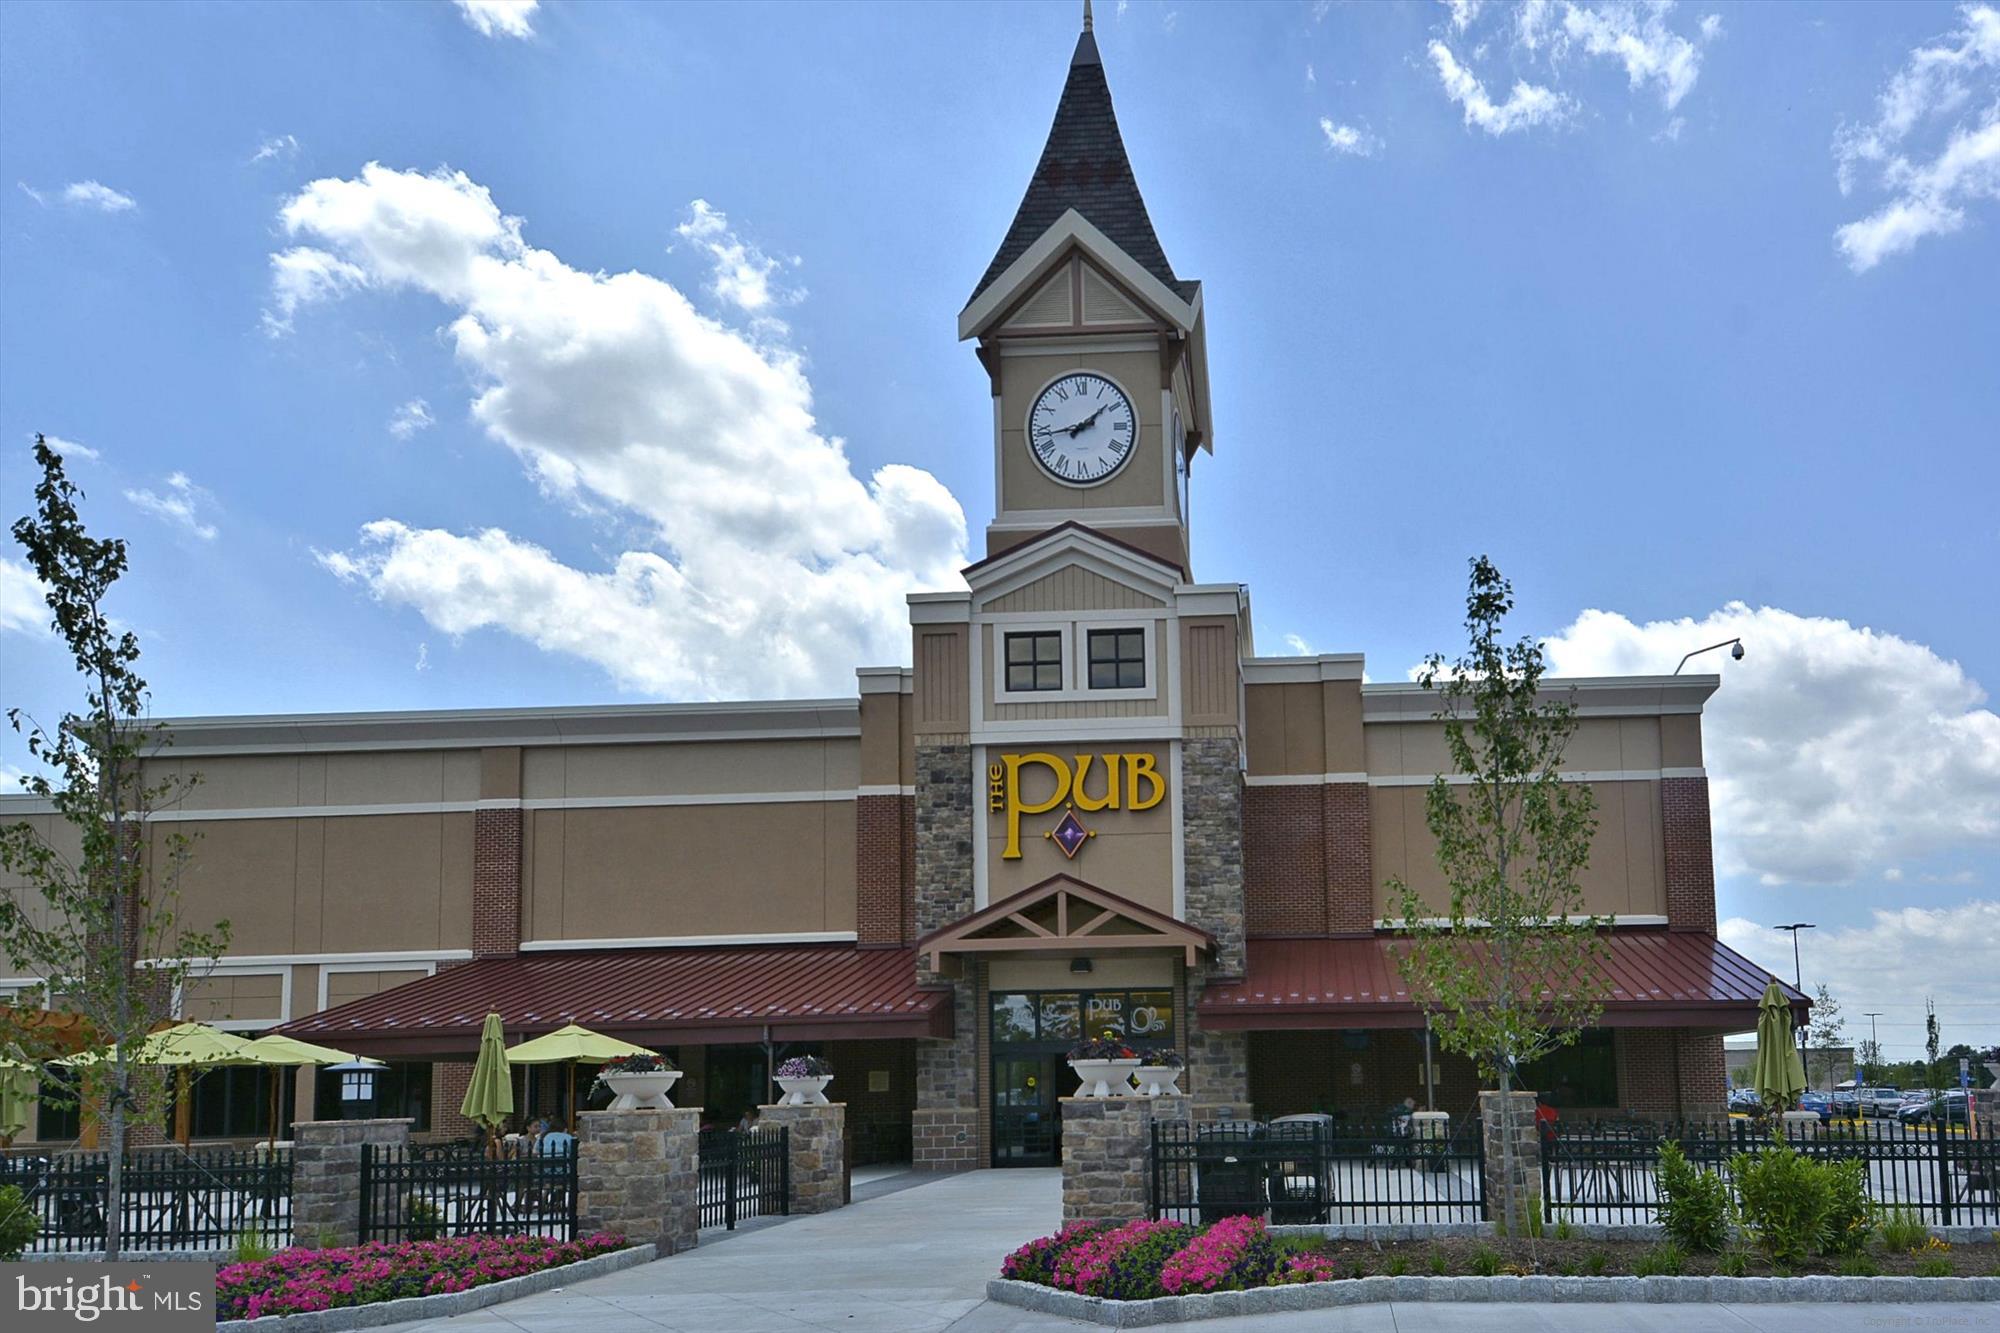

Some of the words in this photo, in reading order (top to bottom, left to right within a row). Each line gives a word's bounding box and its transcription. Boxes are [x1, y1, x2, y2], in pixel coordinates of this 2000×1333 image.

[1055, 387, 1068, 402] XI
[1042, 404, 1055, 416] X
[989, 763, 1004, 813] THE
[1000, 752, 1167, 860] PUB
